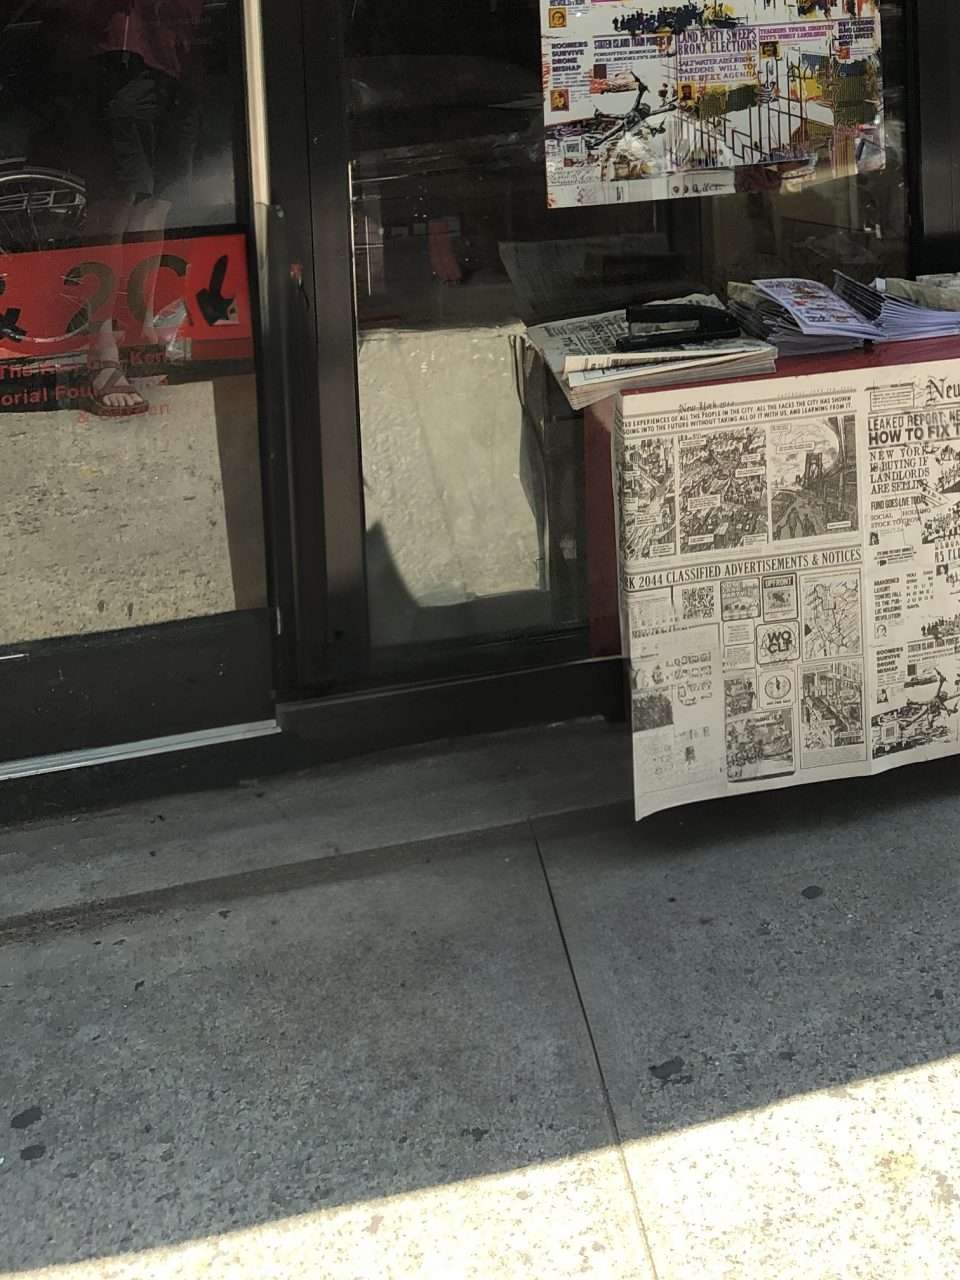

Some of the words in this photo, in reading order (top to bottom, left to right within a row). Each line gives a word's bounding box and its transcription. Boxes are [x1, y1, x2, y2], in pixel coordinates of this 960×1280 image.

[700, 30, 725, 42] PARTY
[727, 29, 757, 41] SWEEPS
[678, 42, 707, 56] BRONX
[711, 40, 757, 53] ELECTIONS
[867, 415, 904, 432] LEAKED
[868, 430, 901, 446] HOW
[904, 427, 924, 441] TO
[927, 424, 951, 439] FIX
[638, 574, 663, 588] 2044
[666, 565, 721, 585] CLASSIFIED
[724, 554, 809, 577] ADVERTISEMENTS
[811, 552, 818, 565] &
[822, 548, 862, 564] NOTICES
